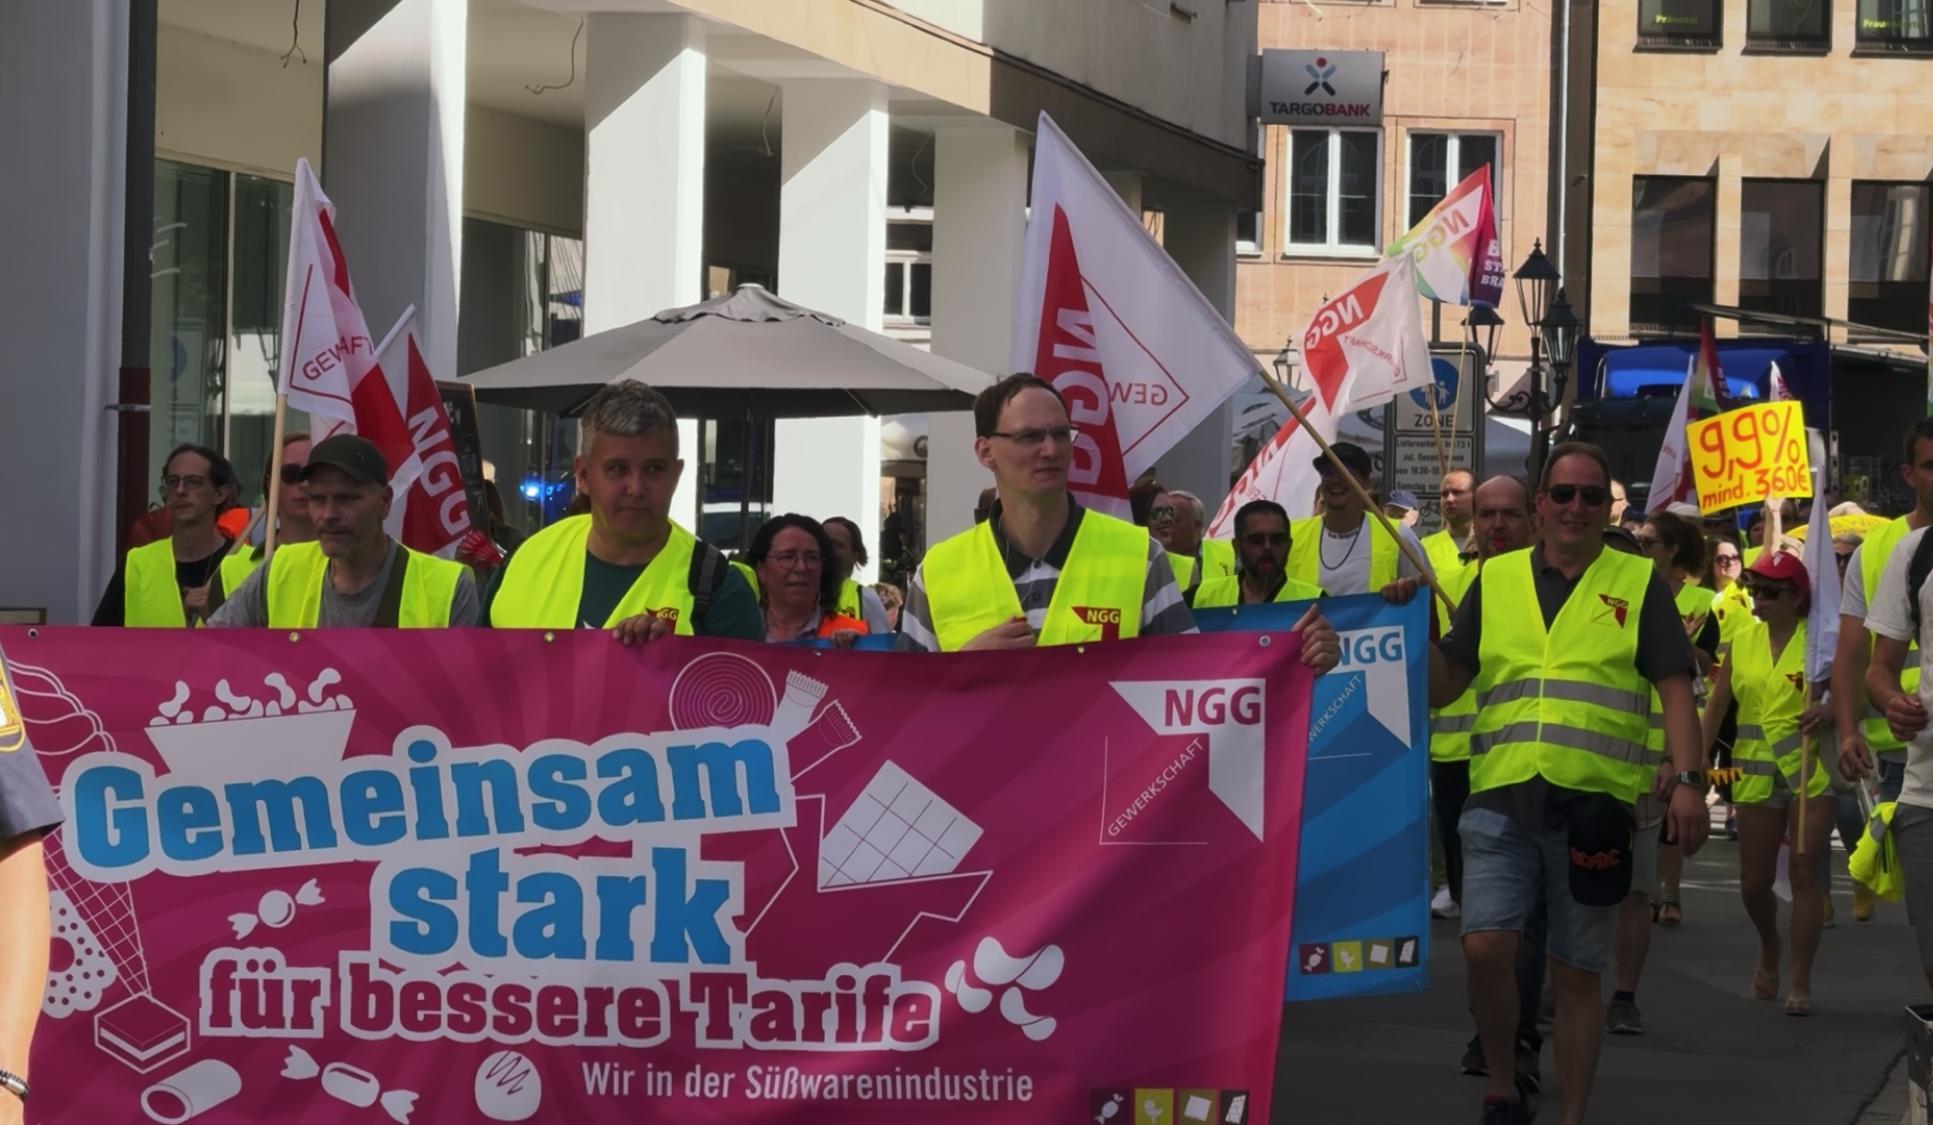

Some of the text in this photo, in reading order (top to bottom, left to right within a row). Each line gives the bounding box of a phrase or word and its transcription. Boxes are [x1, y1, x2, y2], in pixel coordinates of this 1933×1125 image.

[1269, 101, 1371, 117] TARGOBANK
[1414, 414, 1455, 428] ZONE
[1700, 405, 1800, 481] 9,9%
[408, 405, 471, 536] NGG
[1702, 463, 1809, 510] mind. 360€
[1087, 609, 1119, 624] NGG
[1165, 686, 1261, 727] NGG
[1308, 674, 1362, 743] WERKSCHAFT
[74, 738, 781, 868] Gemeinsam
[1108, 738, 1203, 836] GEWERKSCHAFT
[388, 847, 731, 966] stark
[209, 958, 931, 1044] für bessere Tarife
[581, 1061, 1034, 1101] Wir in der Süßwarenindustrie
